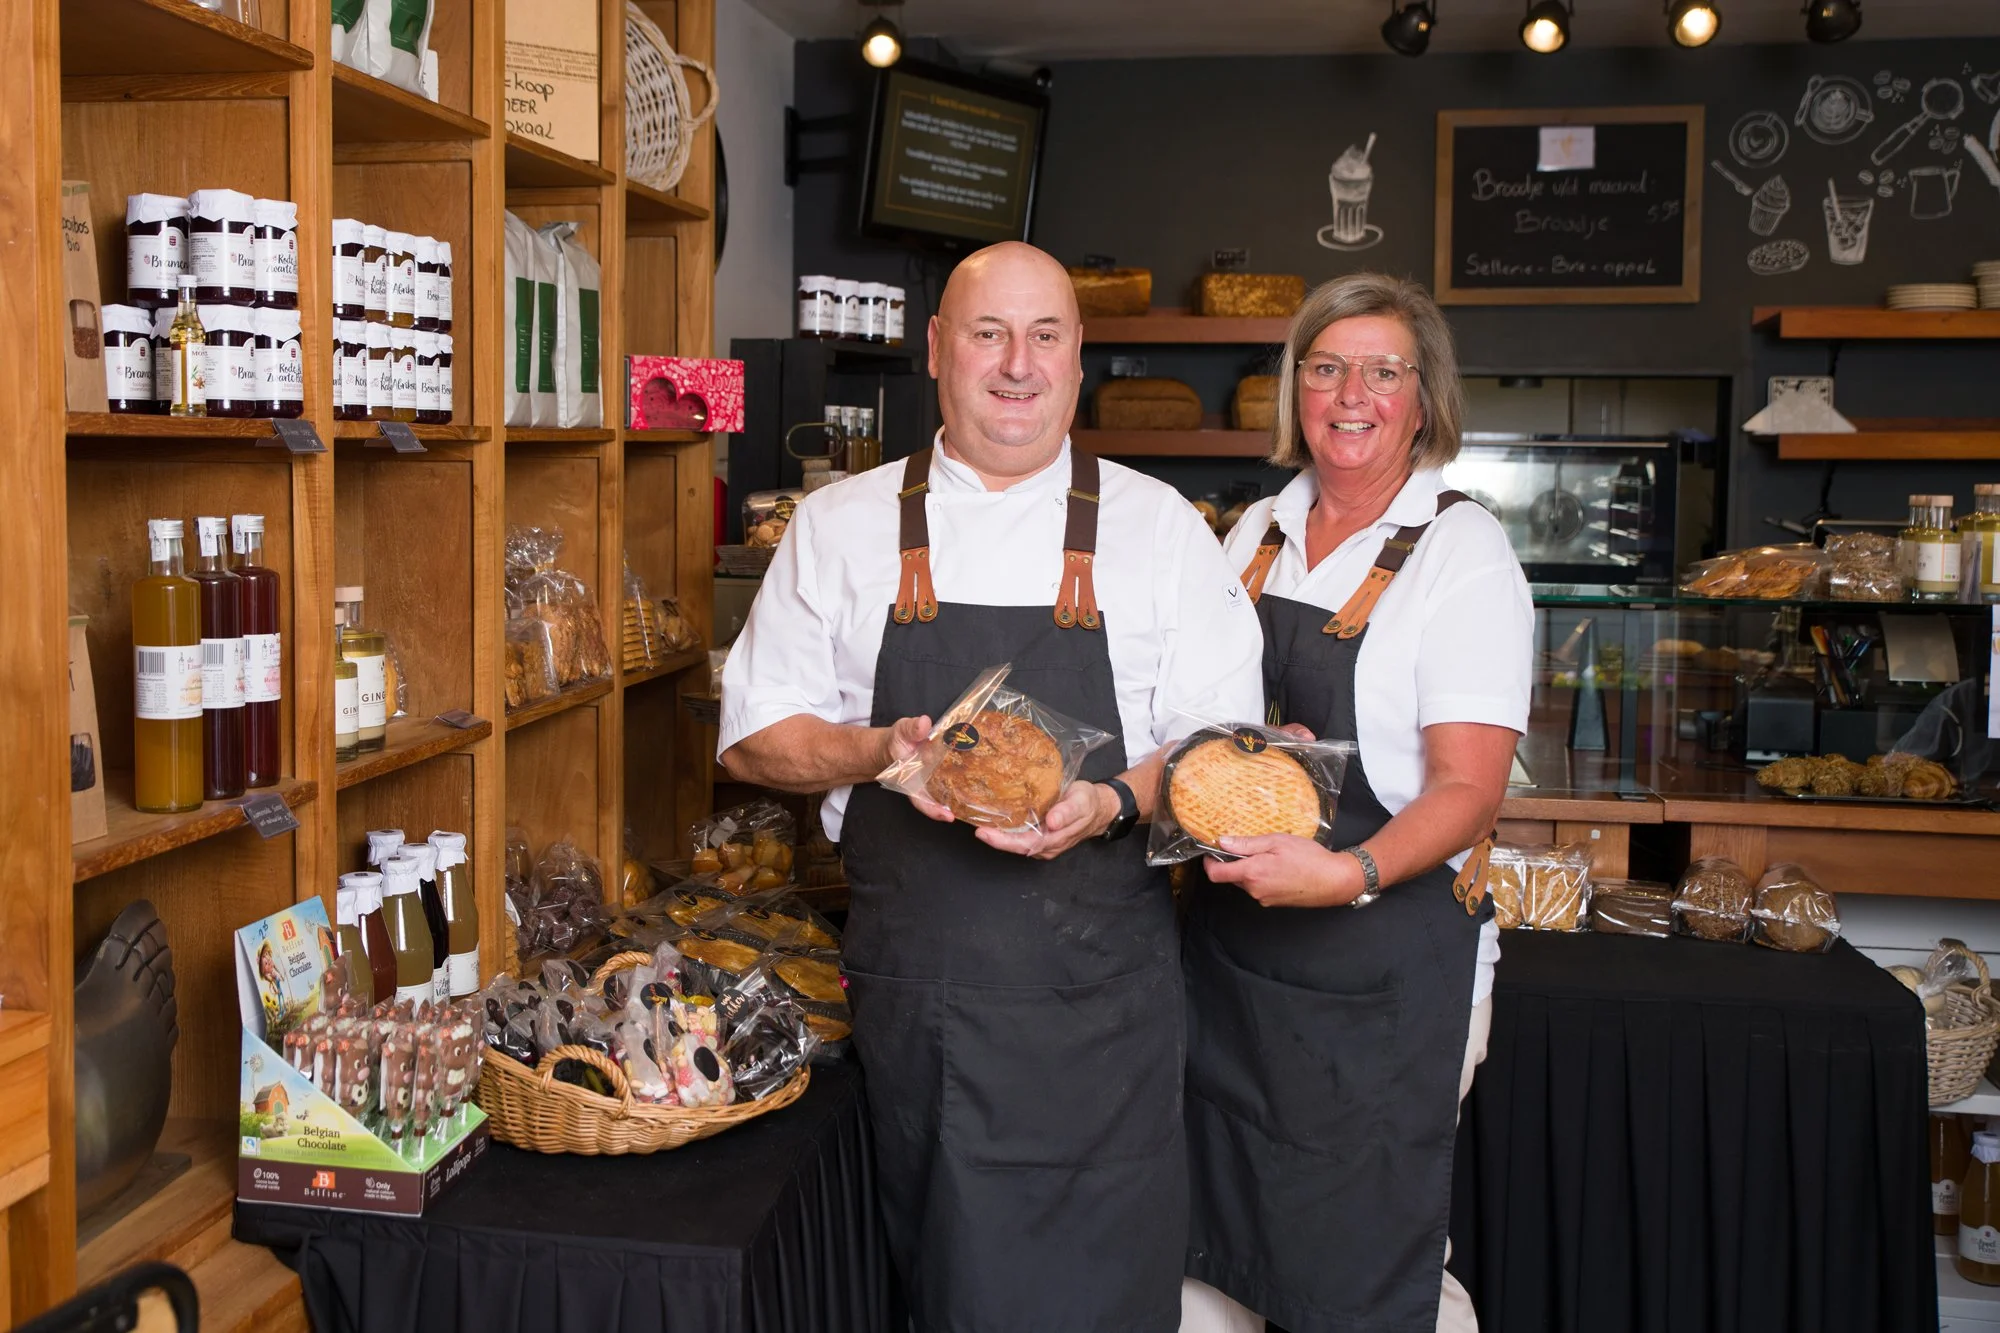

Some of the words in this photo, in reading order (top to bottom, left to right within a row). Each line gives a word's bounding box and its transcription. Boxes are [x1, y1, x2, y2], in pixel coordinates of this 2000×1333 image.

[514, 73, 555, 103] koop
[1472, 168, 1545, 201] Broodje
[1514, 209, 1610, 240] Broodje
[1552, 255, 1586, 275] Brie
[287, 951, 307, 966] Belgian
[289, 961, 313, 978] Chocolate
[303, 1126, 341, 1138] Belgian
[297, 1138, 347, 1151] Chocolate
[262, 1171, 280, 1180] 100%
[303, 1188, 344, 1199] Belfine
[375, 1181, 391, 1191] Only
